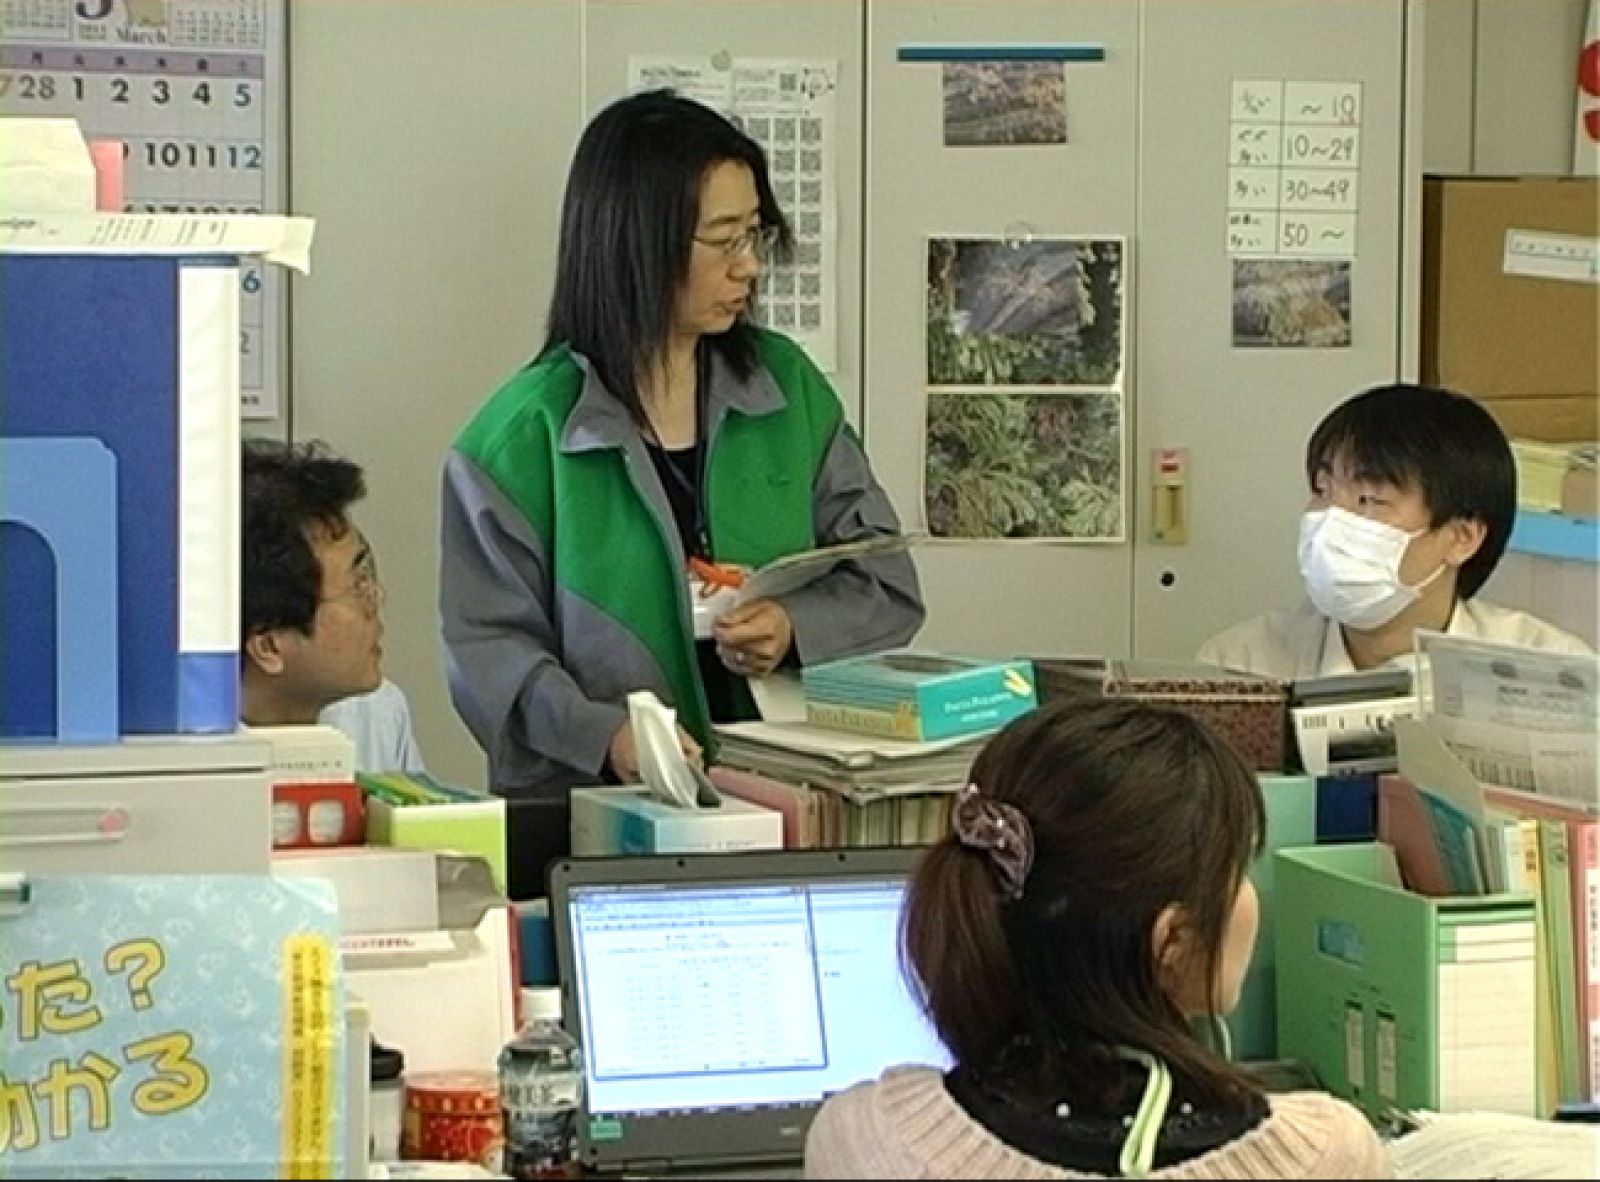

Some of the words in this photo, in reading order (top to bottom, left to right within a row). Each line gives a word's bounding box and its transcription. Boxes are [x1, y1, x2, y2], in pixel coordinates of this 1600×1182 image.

[19, 74, 55, 99] 28
[73, 78, 84, 100] 1
[111, 79, 128, 103] 2
[152, 80, 170, 104] 3
[193, 83, 211, 105] 4
[234, 85, 251, 106] 5
[146, 143, 180, 166] 10
[188, 145, 216, 167] 11
[229, 147, 261, 168] 12
[0, 938, 165, 1041] た？
